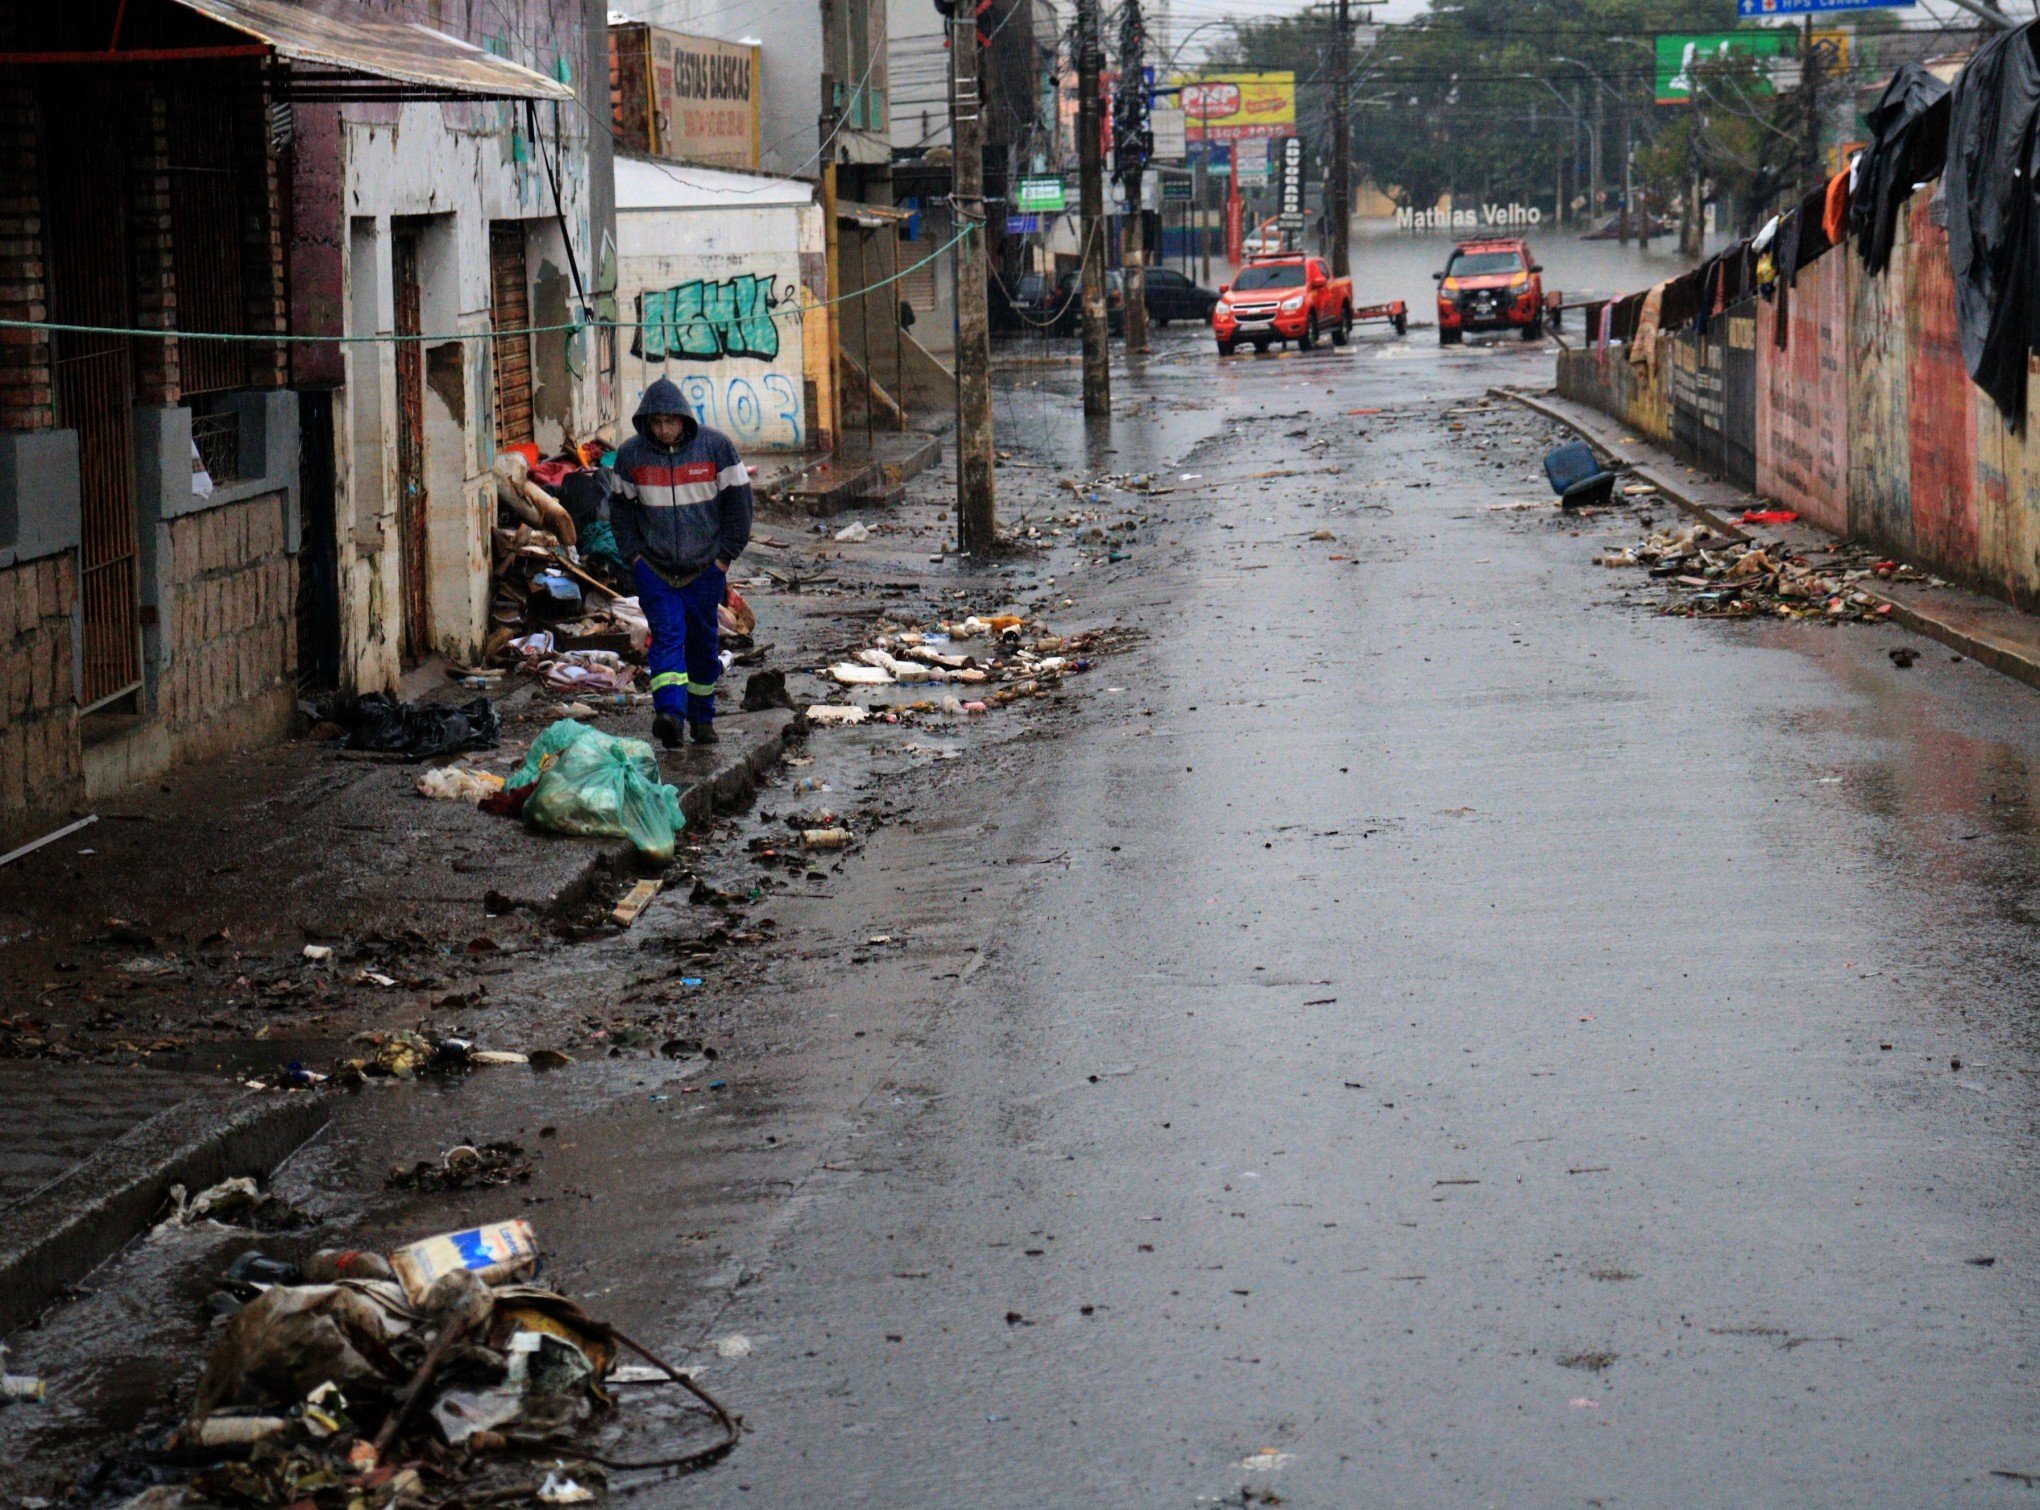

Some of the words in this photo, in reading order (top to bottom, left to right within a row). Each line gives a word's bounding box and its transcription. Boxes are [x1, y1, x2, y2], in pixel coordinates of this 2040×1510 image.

[674, 47, 708, 100] CESTAS
[1396, 206, 1477, 228] Mathias
[1482, 201, 1541, 226] Velho
